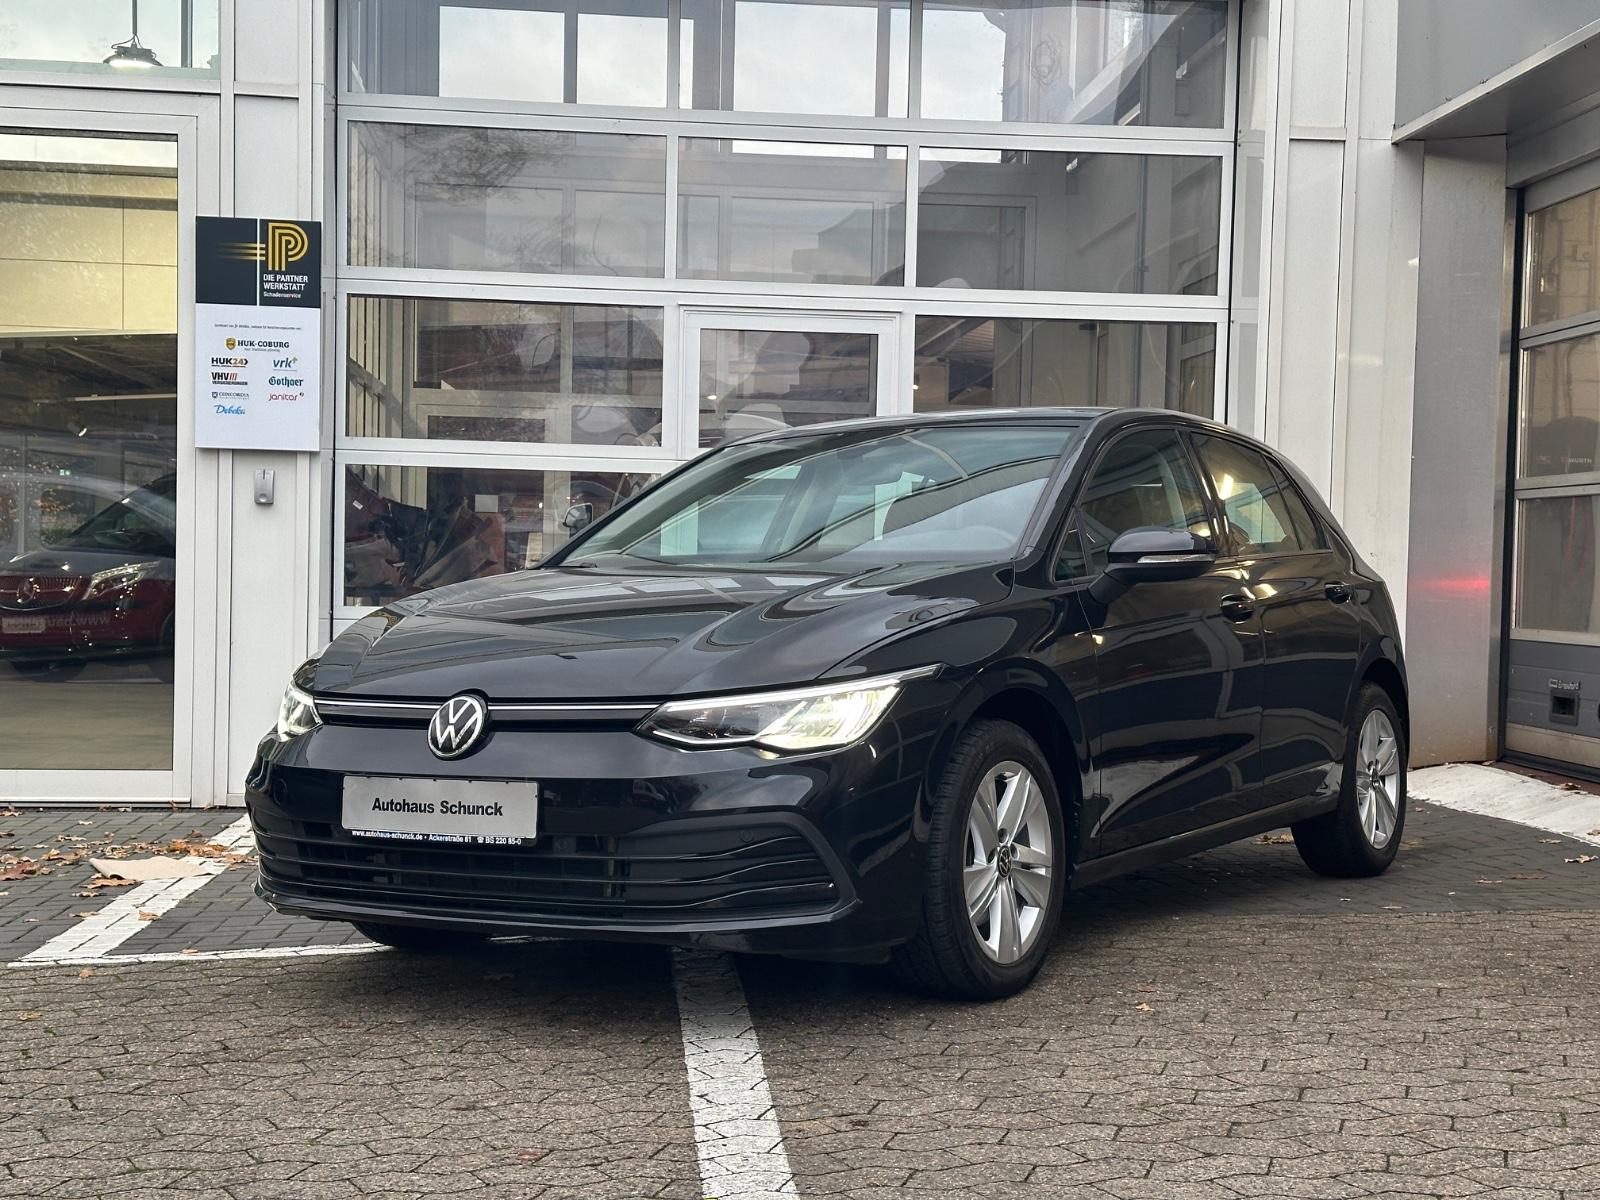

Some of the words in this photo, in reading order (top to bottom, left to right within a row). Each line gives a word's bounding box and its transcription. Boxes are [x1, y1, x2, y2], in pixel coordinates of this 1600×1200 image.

[263, 273, 275, 281] DIE
[276, 274, 308, 283] PARTNER
[263, 281, 305, 291] WERKSTATT
[211, 371, 229, 381] VHV
[268, 375, 304, 388] Gothaer
[371, 797, 434, 814] Autohaus
[440, 800, 503, 816] Schunck
[495, 837, 507, 845] 220
